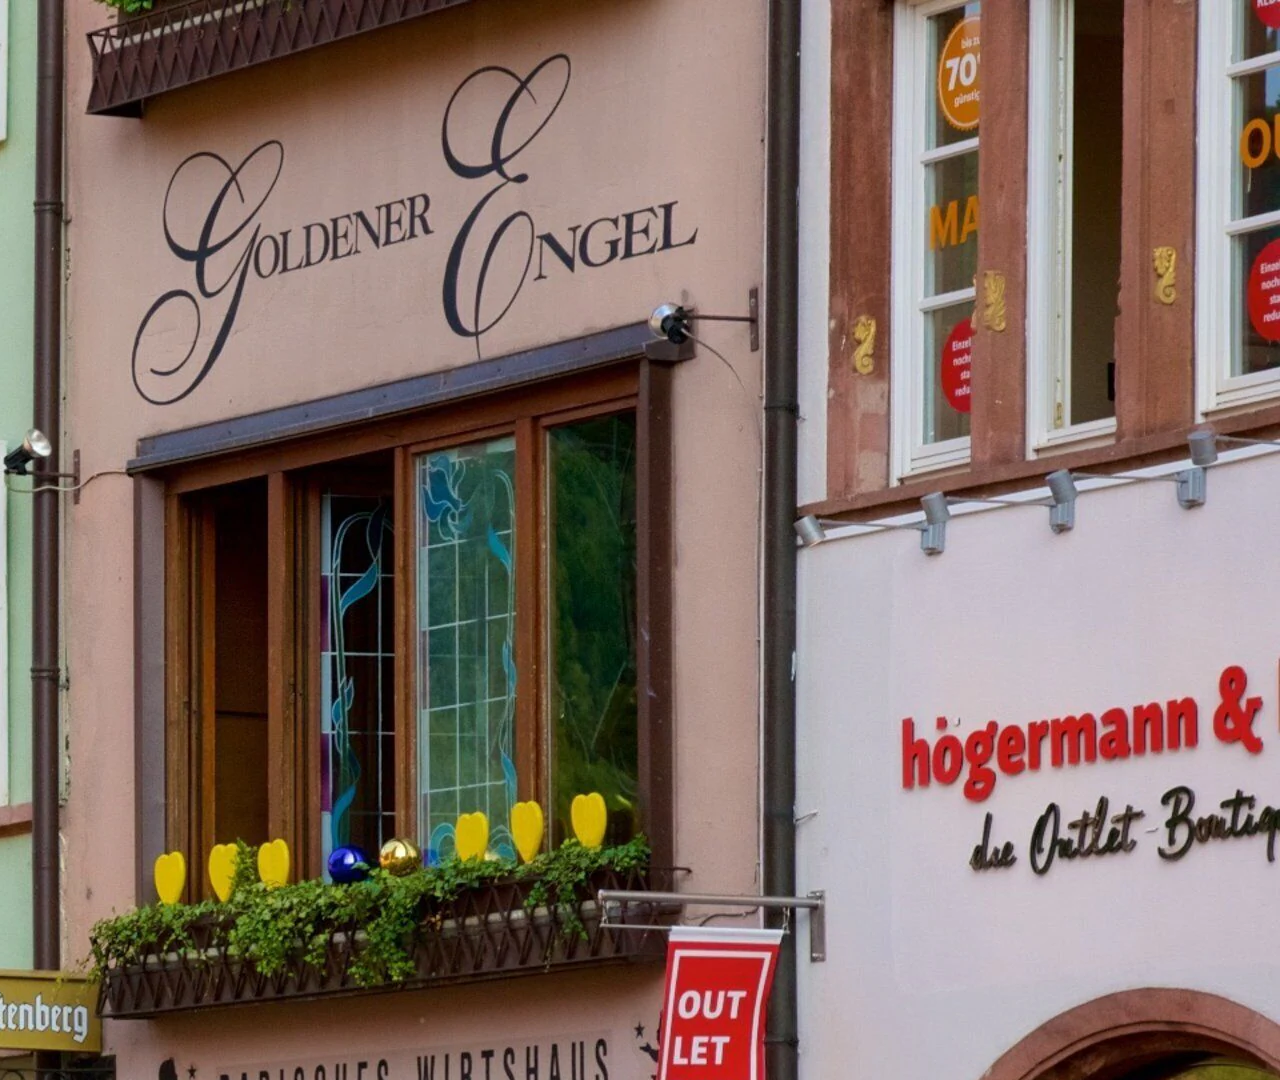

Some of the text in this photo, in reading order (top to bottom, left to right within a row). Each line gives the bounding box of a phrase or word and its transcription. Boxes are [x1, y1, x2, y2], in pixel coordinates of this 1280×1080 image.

[945, 52, 980, 91] 70
[1240, 113, 1280, 169] O
[131, 53, 698, 406] GOLDENER ENGEL
[1213, 665, 1264, 754] &
[677, 990, 747, 1020] OUT
[672, 1035, 731, 1066] LET
